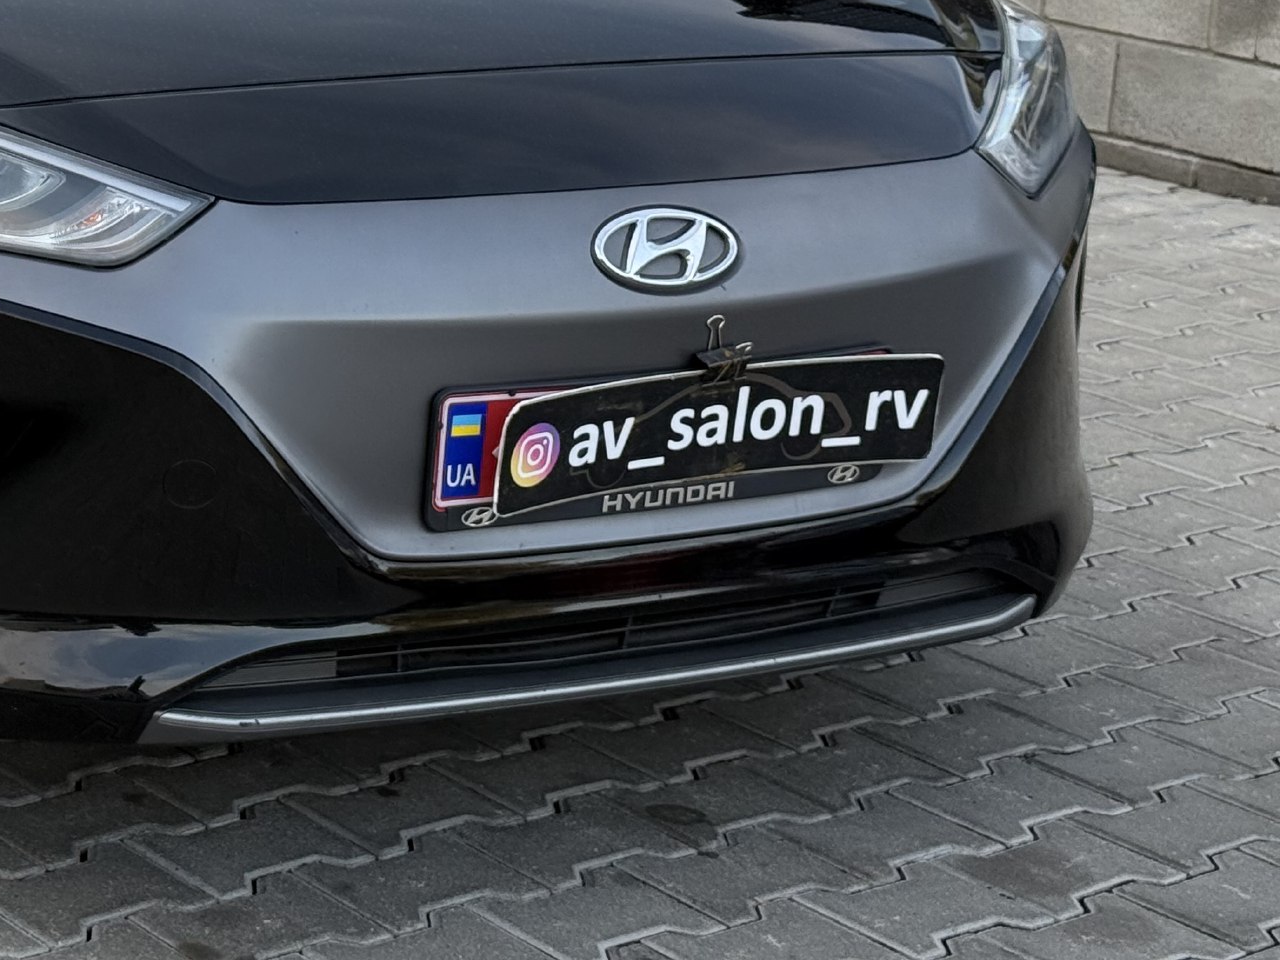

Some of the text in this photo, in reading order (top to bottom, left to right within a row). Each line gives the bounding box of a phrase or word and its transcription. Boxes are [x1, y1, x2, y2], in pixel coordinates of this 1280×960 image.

[568, 385, 930, 470] av_salon_rv
[446, 463, 477, 488] UA
[601, 480, 736, 514] HYUNDAI
